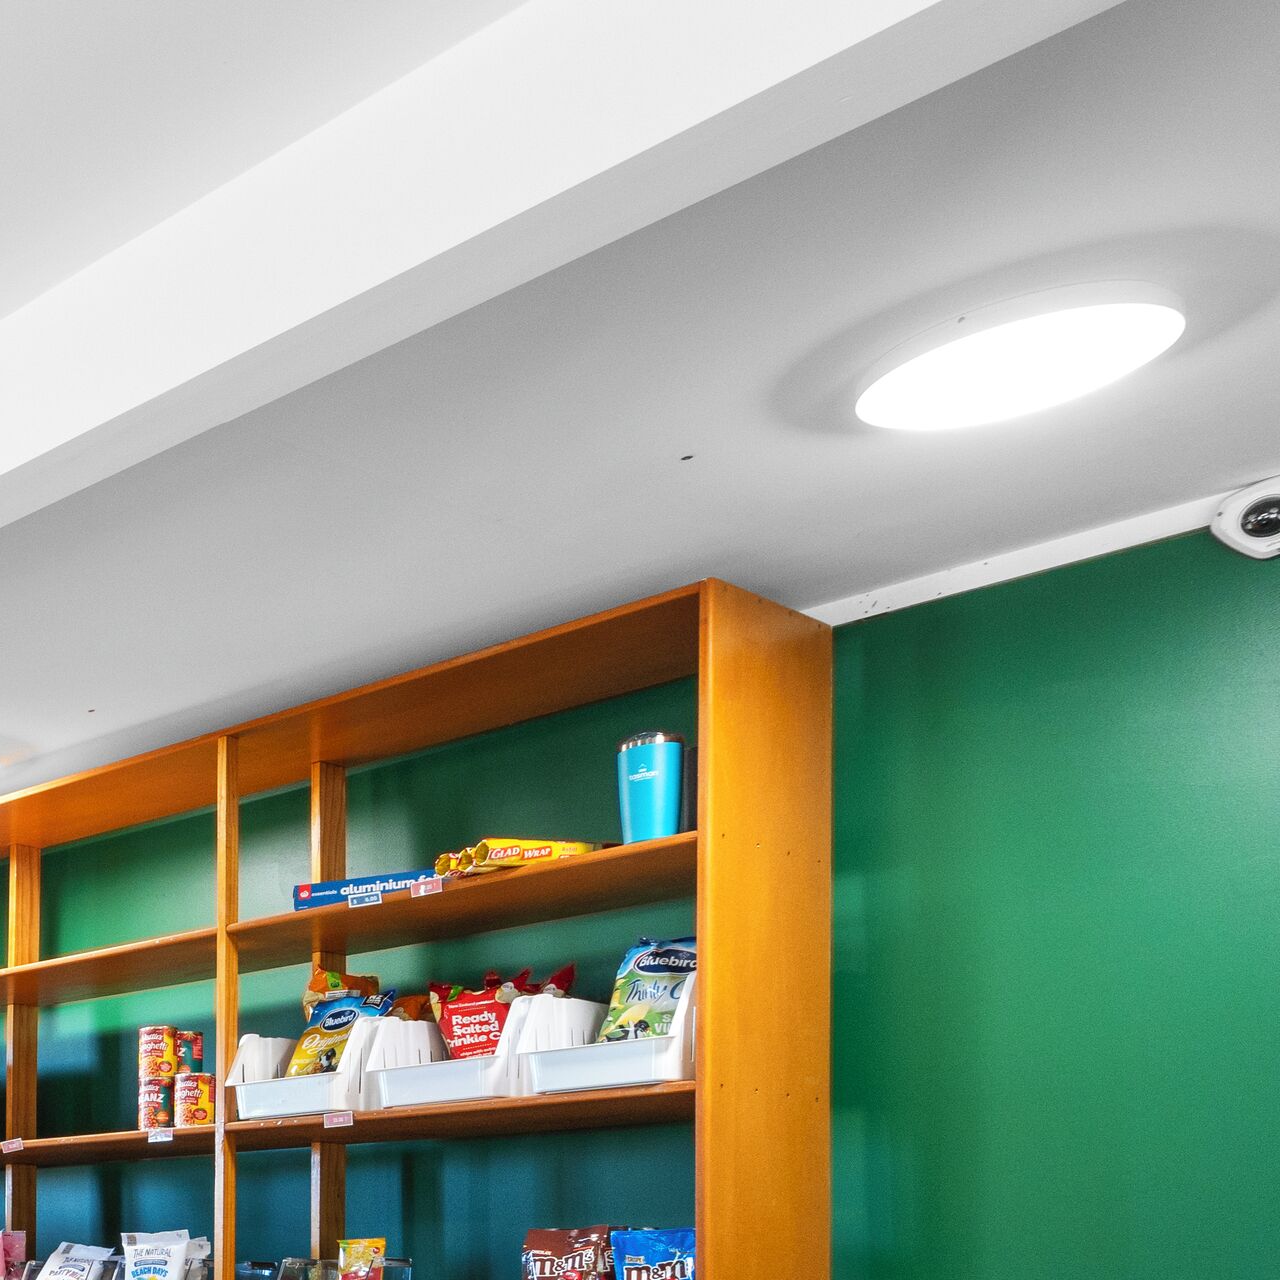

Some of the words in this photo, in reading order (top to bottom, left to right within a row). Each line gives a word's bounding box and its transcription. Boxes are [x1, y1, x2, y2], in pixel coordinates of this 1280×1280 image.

[491, 847, 520, 859] GLAD
[523, 847, 551, 859] WRAP
[340, 878, 416, 896] aluminium
[323, 1011, 355, 1028] Bluebird
[452, 1011, 497, 1026] Ready
[453, 1022, 500, 1036] Salted
[134, 1249, 143, 1258] THE
[144, 1247, 173, 1258] NATURAL
[131, 1267, 152, 1278] BEACH
[152, 1266, 169, 1277] DAYS
